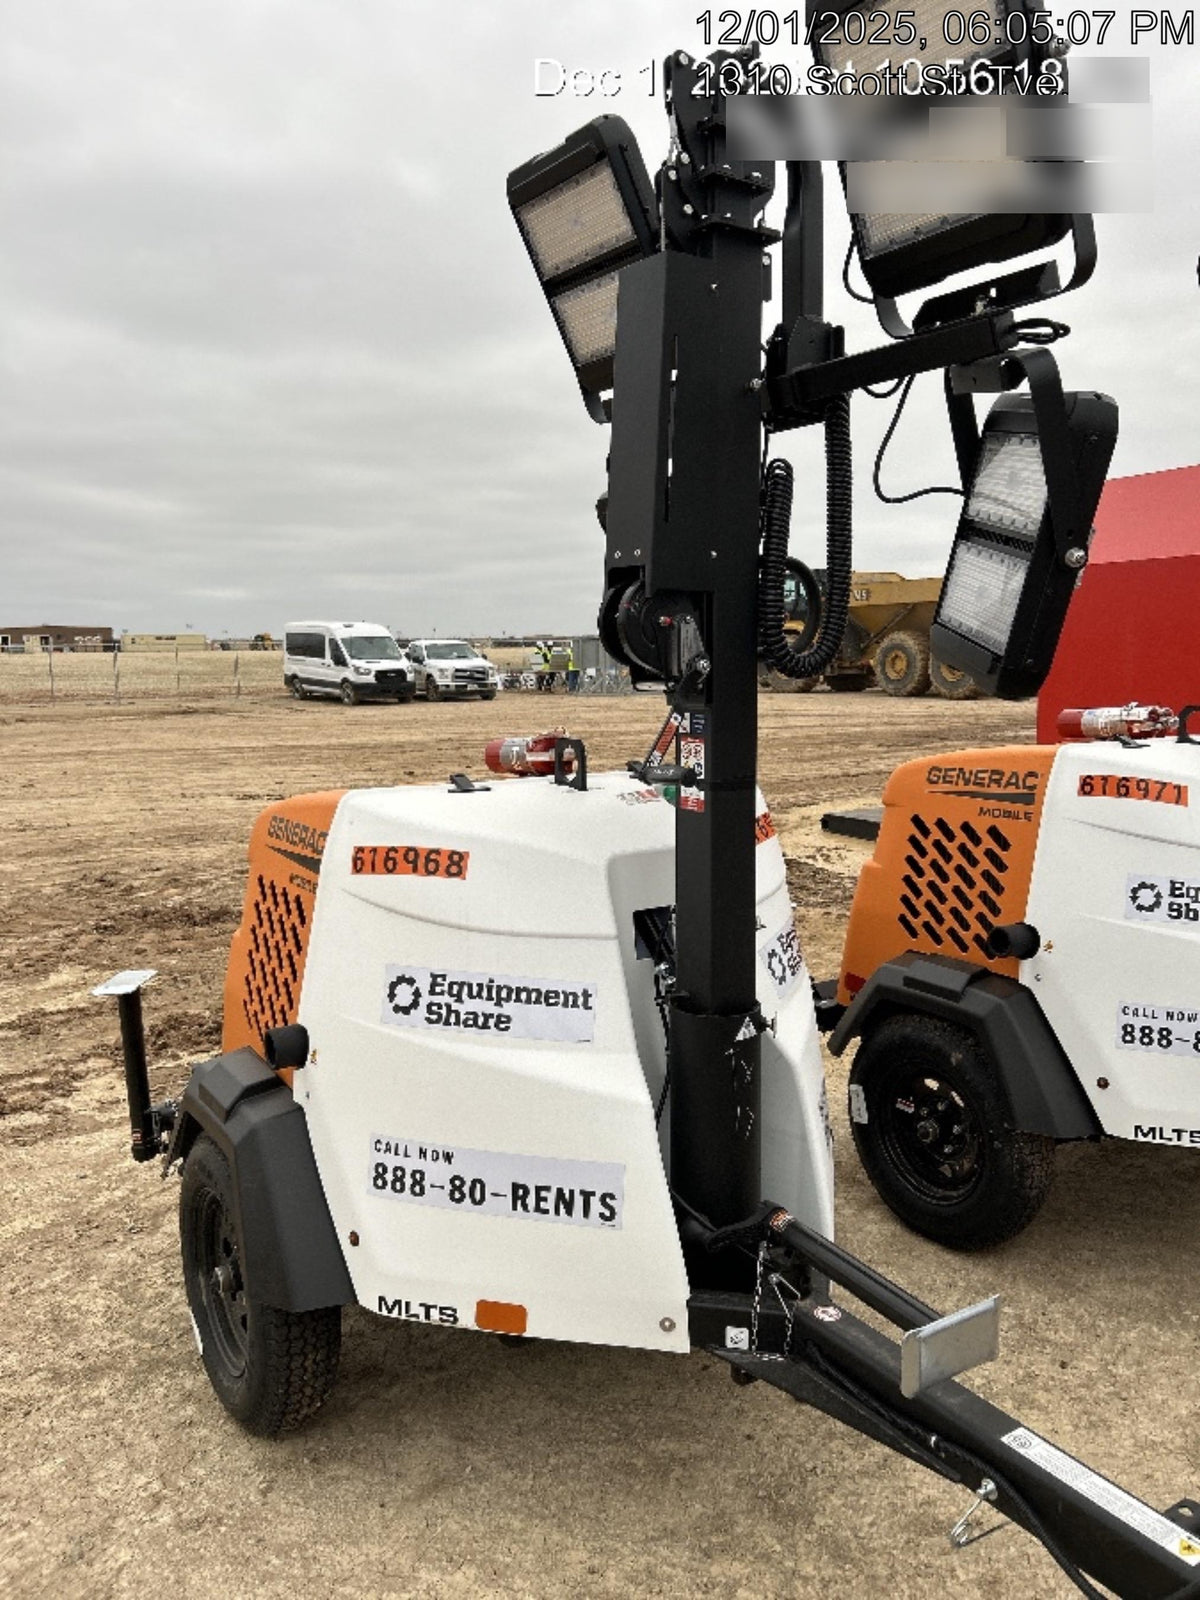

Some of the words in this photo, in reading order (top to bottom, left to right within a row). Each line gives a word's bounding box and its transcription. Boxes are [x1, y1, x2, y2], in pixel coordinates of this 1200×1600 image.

[925, 766, 1039, 792] GENERAC
[1081, 775, 1183, 805] 616971
[978, 806, 1034, 822] MOBILE
[352, 846, 466, 879] 616968
[427, 971, 593, 1011] Equipment
[424, 1002, 513, 1033] Share
[1121, 1005, 1159, 1020] CALL
[1166, 1010, 1198, 1023] NOW
[374, 1138, 412, 1159] CALL
[418, 1146, 455, 1165] NOW
[371, 1161, 617, 1222] 888-80-RENTS
[377, 1295, 459, 1326] MLTS
